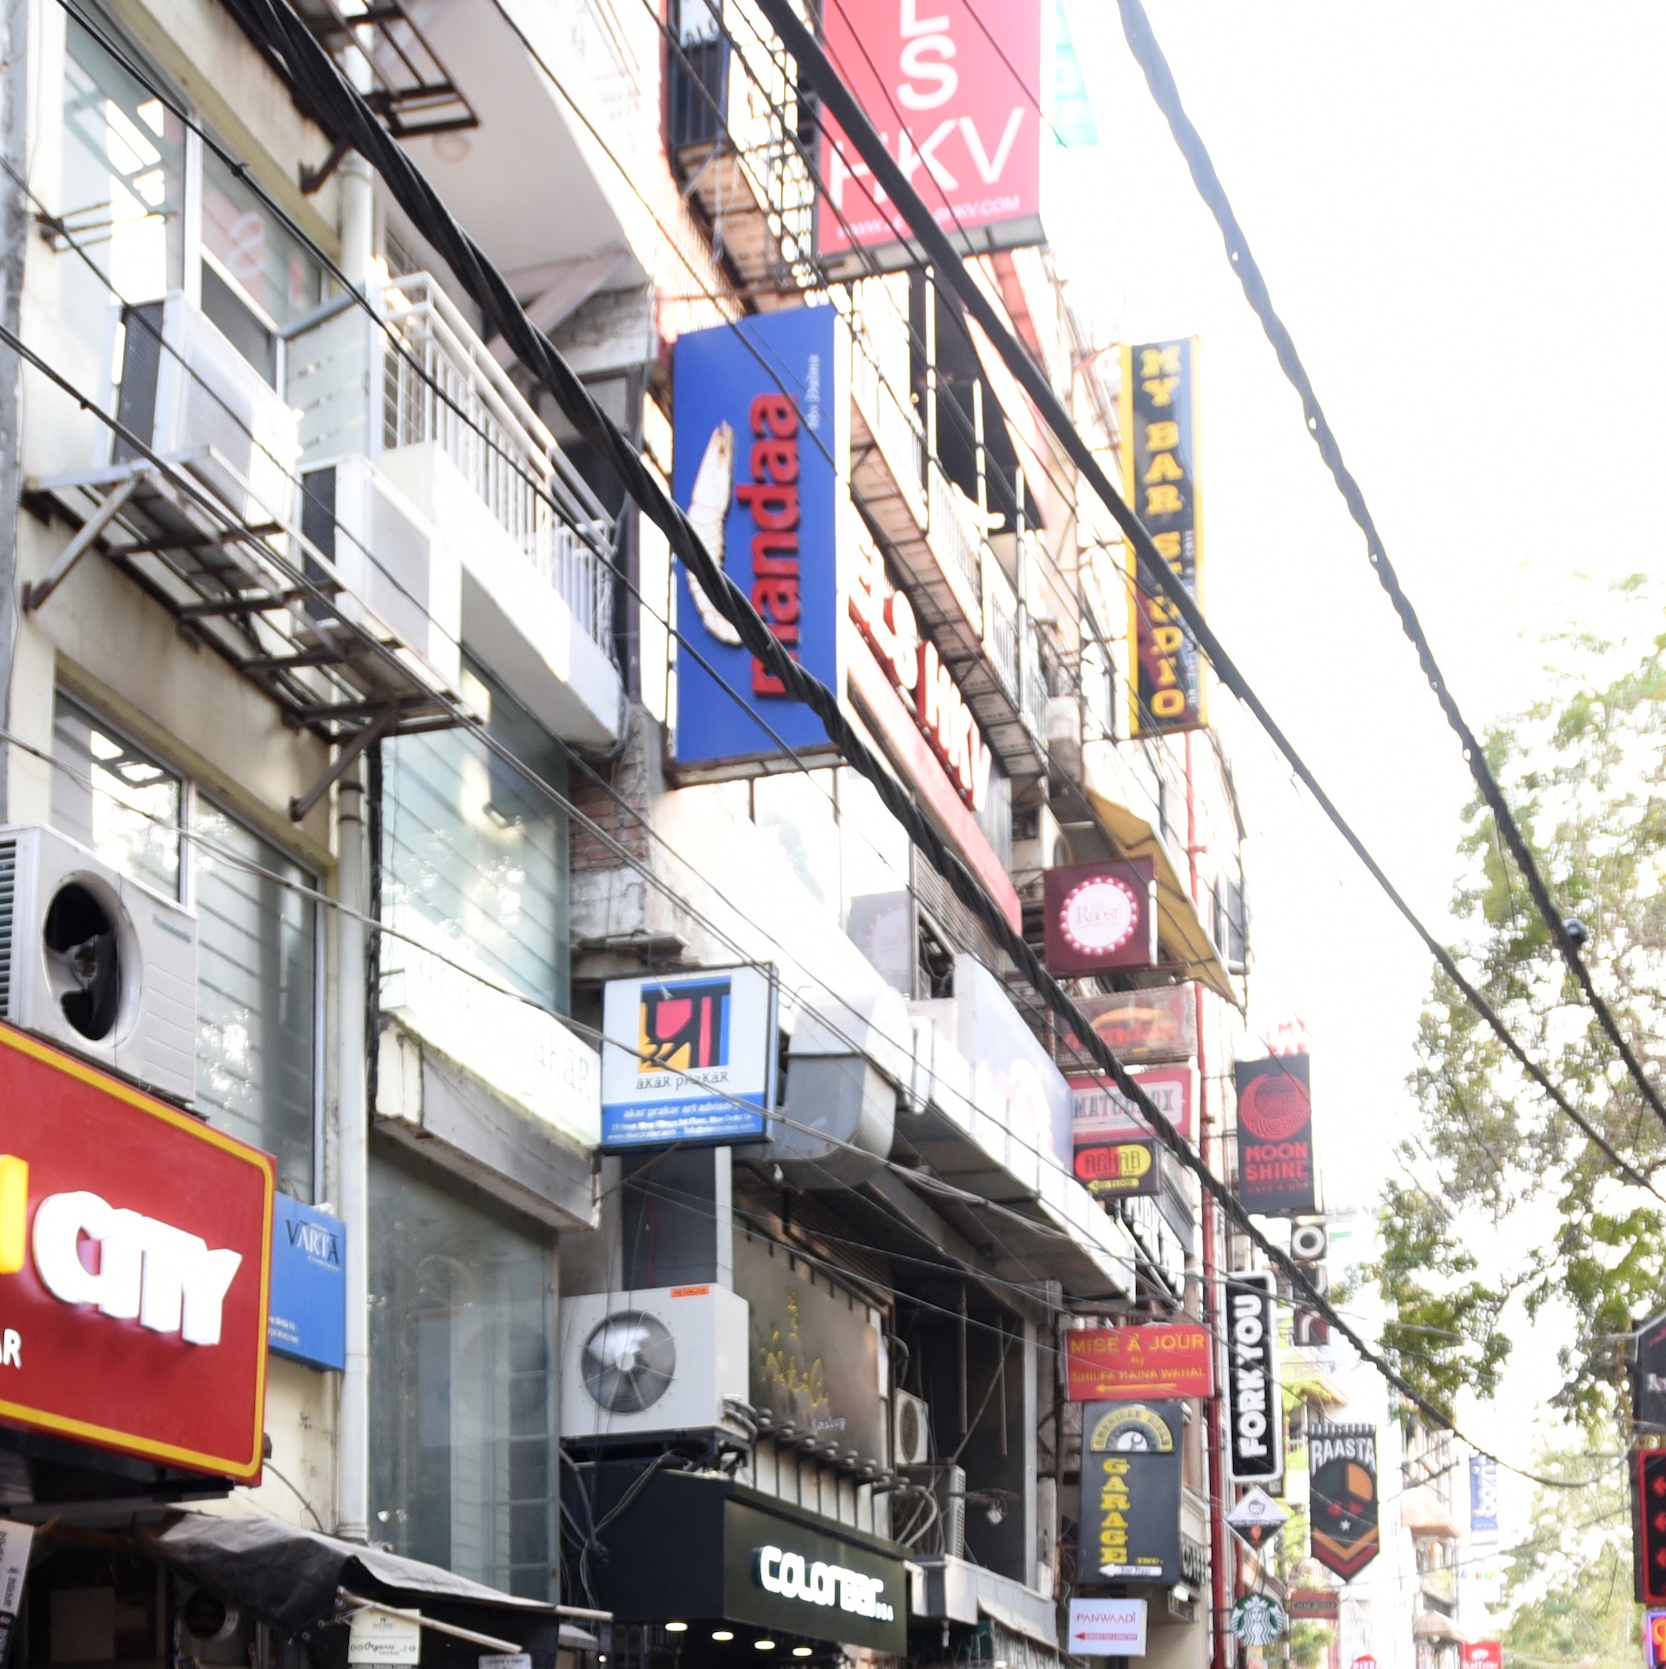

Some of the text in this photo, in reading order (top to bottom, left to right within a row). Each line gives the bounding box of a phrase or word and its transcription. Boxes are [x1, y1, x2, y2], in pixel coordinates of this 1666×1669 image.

[829, 106, 1026, 211] HKV
[1140, 344, 1182, 408] MY
[1144, 420, 1185, 515] BAR
[1244, 1141, 1309, 1163] MOON
[1245, 1161, 1309, 1182] SHINE
[31, 1188, 244, 1347] CITY
[1071, 1332, 1205, 1354] MISE JOUR
[1311, 1436, 1377, 1478] RAASTA
[1099, 1457, 1131, 1565] GARAGE
